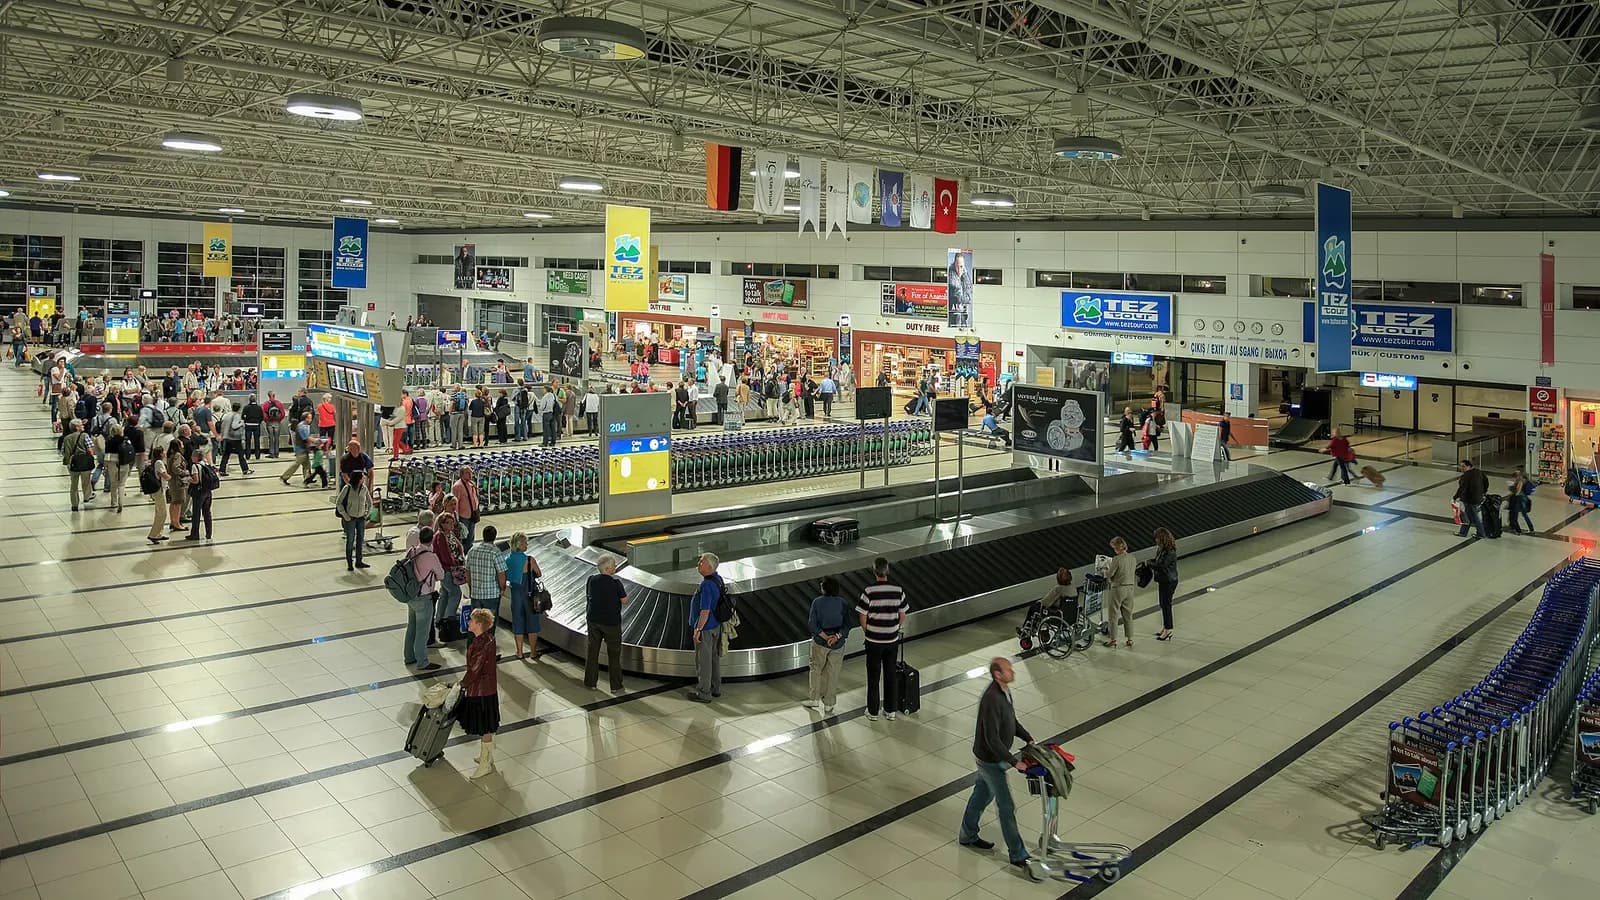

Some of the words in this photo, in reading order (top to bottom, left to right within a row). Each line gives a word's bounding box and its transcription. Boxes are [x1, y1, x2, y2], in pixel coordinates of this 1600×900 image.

[610, 265, 643, 274] TEZ
[1322, 292, 1348, 306] TEZ
[1104, 299, 1158, 313] TEZ
[1360, 312, 1434, 327] TEZ
[906, 323, 923, 331] DUTY
[925, 324, 940, 332] FREE
[1104, 321, 1158, 329] www.teztour.com
[1368, 327, 1428, 336] tour
[1362, 336, 1435, 346] www.teztour.com
[1211, 344, 1224, 354] EXIT
[1380, 352, 1425, 360] CUSTOMS
[610, 422, 626, 432] 204
